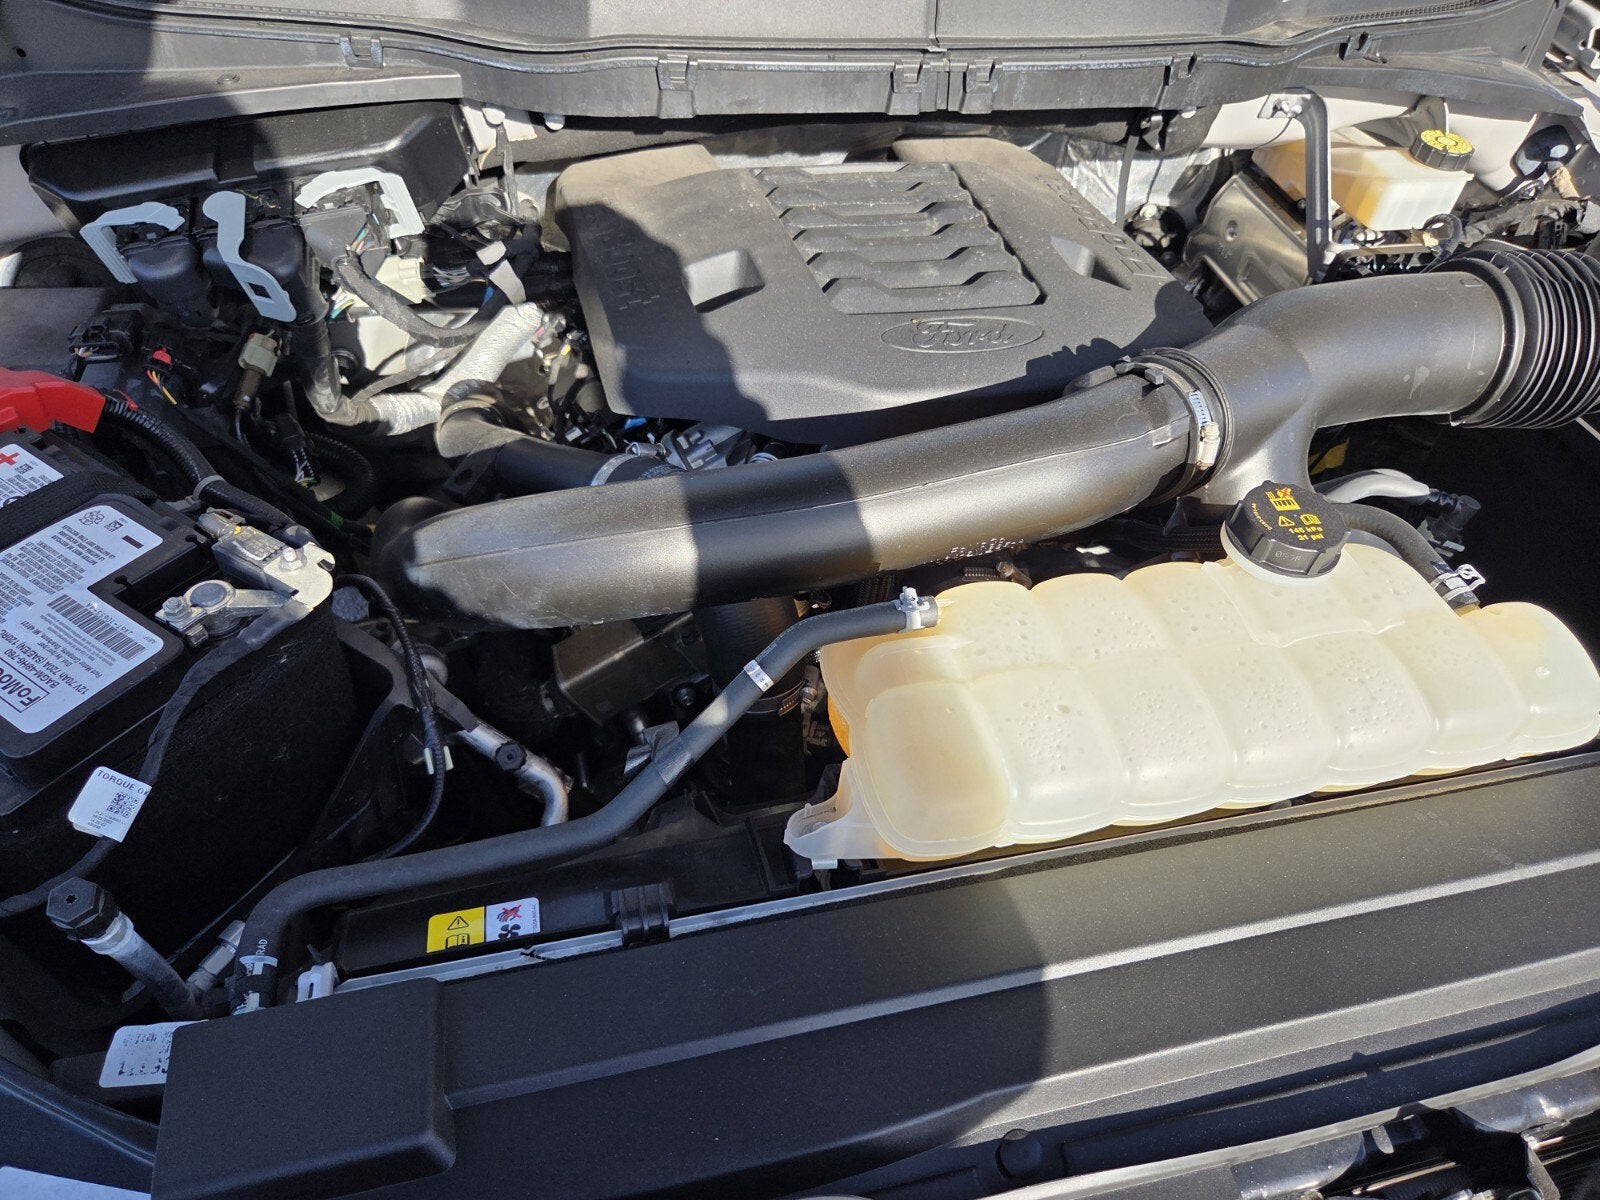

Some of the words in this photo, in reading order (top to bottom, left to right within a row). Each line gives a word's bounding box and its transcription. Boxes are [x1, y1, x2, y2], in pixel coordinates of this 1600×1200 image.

[1034, 175, 1169, 280] ECOBOOST
[912, 320, 1015, 348] Ford
[1310, 533, 1325, 541] psi
[16, 642, 48, 664] (SAE/EN)
[61, 647, 80, 663] Company,
[43, 662, 60, 674] 720A
[78, 661, 92, 671] Motor
[91, 668, 102, 678] Ford
[59, 672, 77, 686] 70Ah
[0, 668, 41, 707] FoMo
[73, 683, 89, 694] 12V
[97, 770, 136, 791] TORQUE
